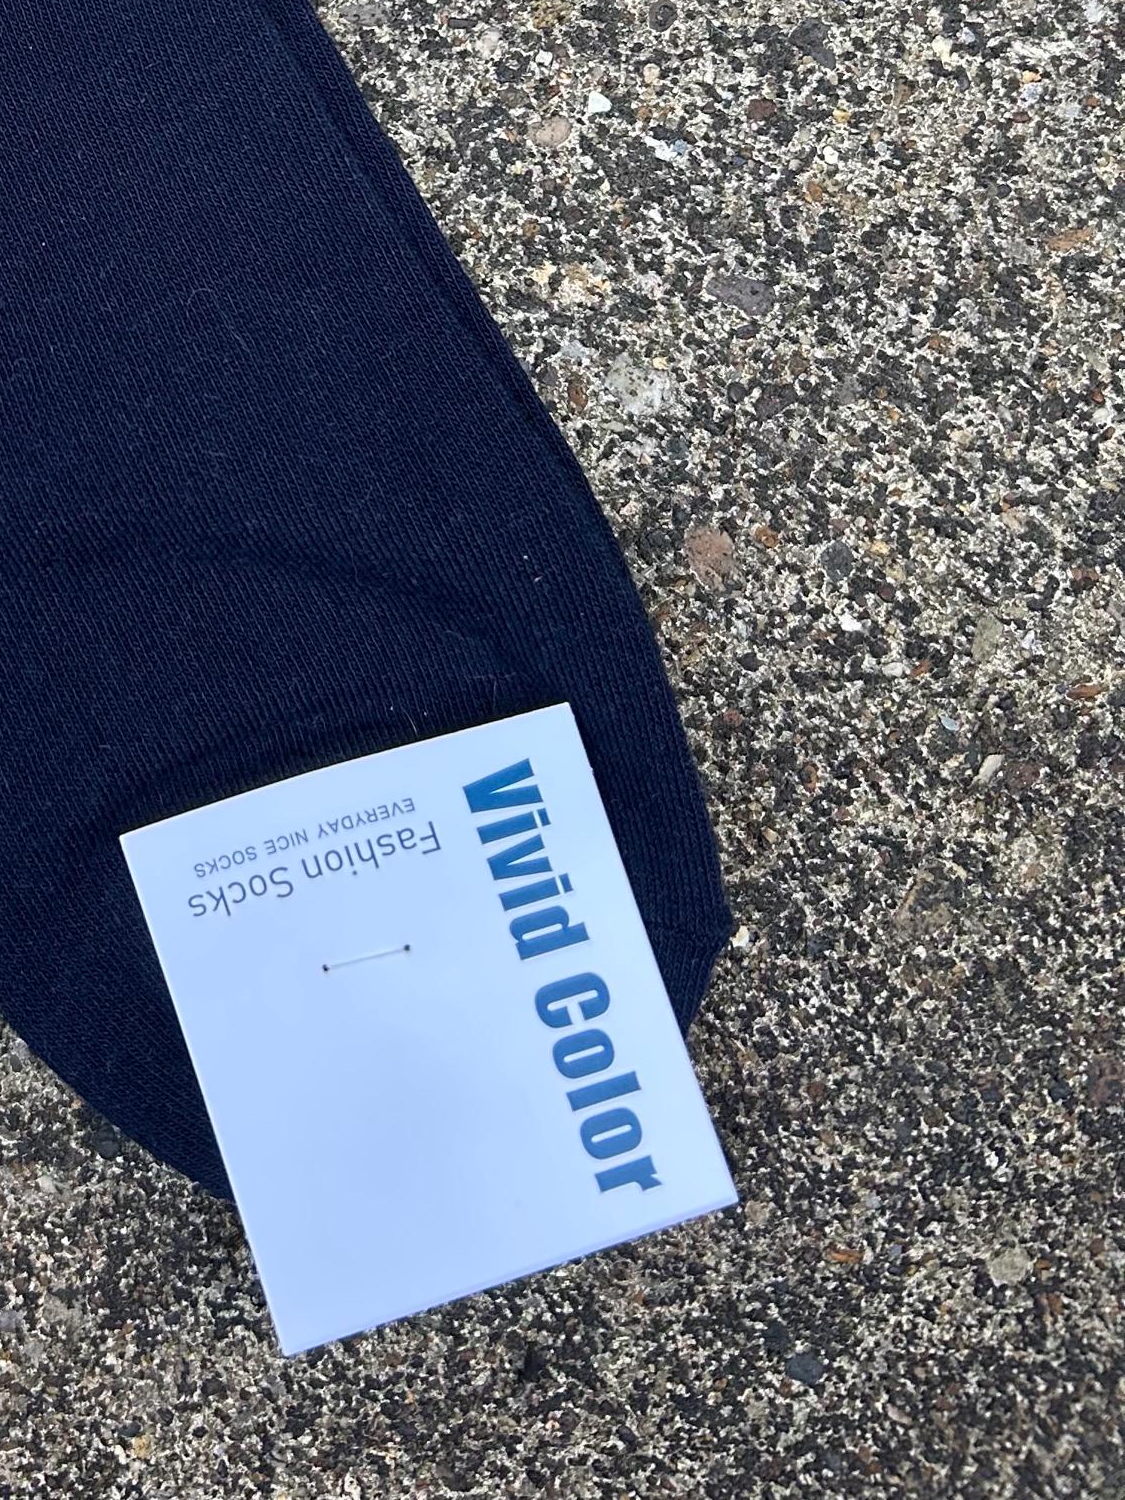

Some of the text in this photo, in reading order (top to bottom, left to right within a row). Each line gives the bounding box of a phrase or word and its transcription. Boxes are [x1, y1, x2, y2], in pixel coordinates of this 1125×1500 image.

[187, 820, 442, 917] Fashion Socks
[193, 797, 416, 878] EVERYDAY NICE SOCKS
[462, 757, 663, 1194] Vivid Color
